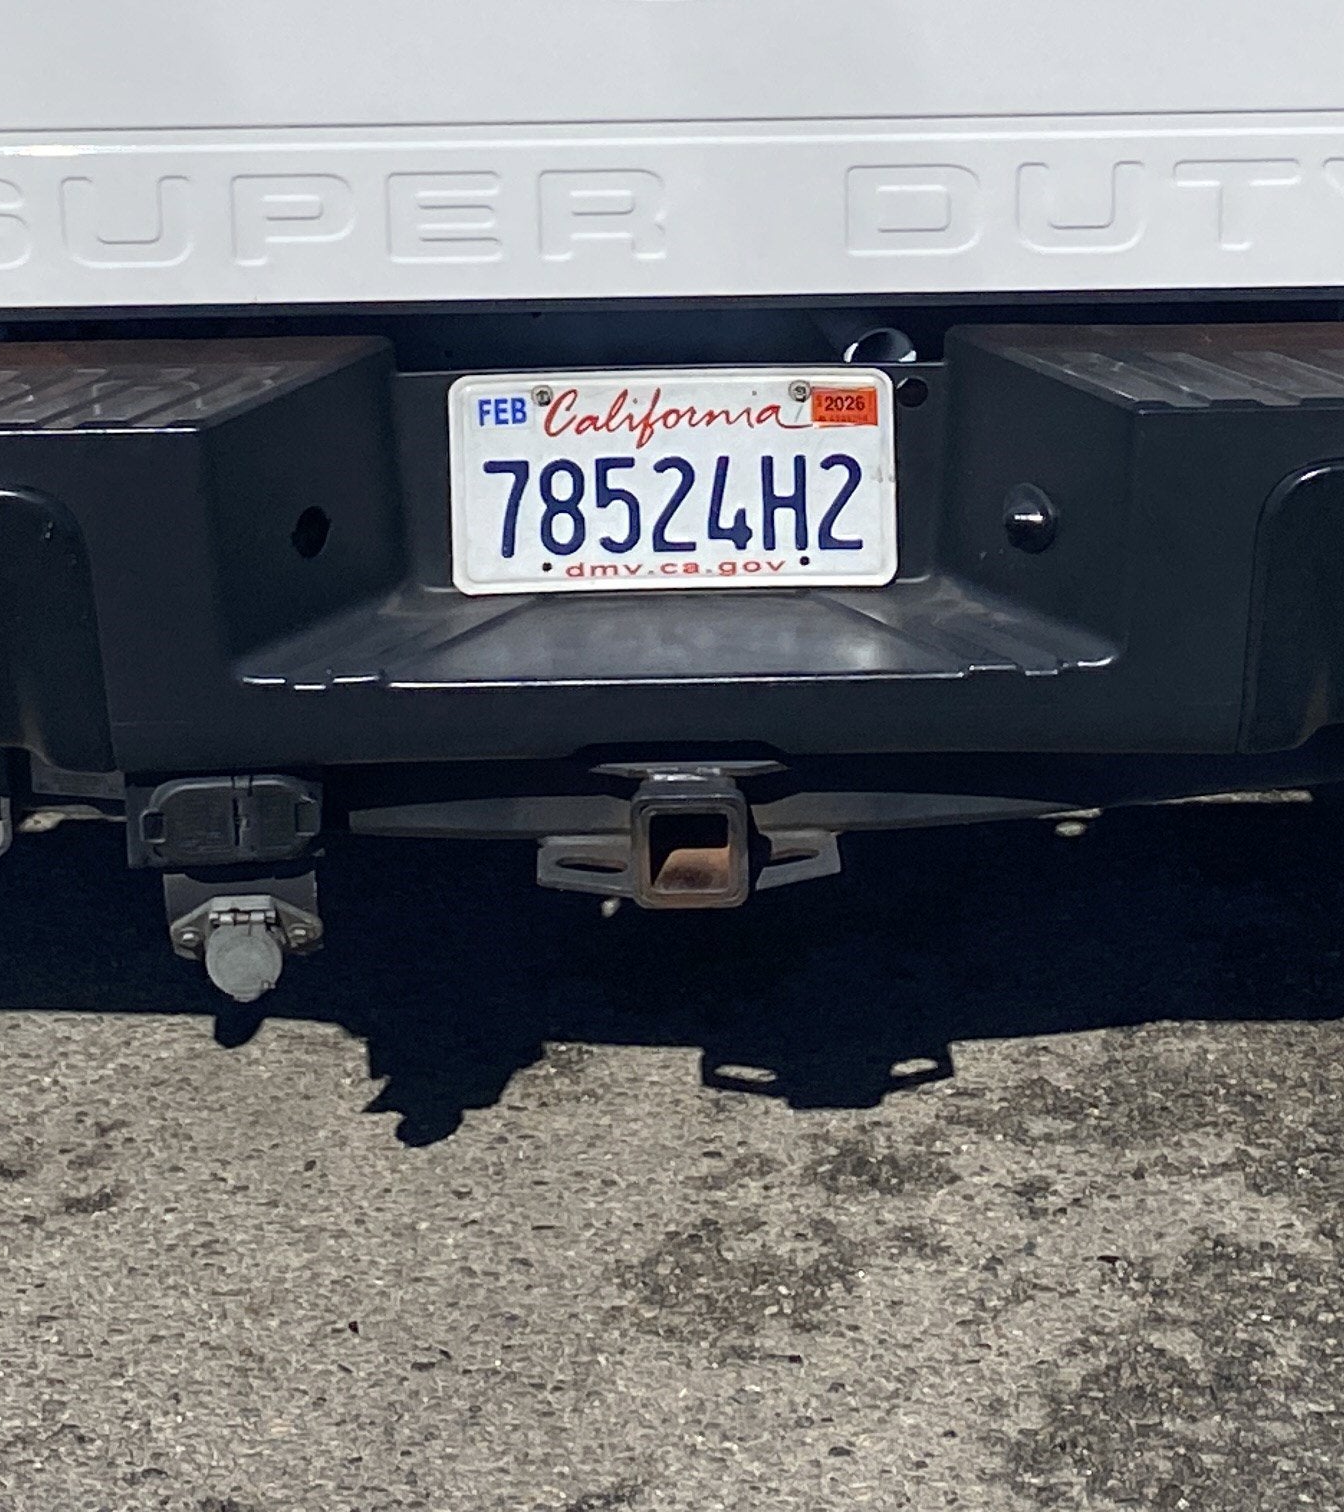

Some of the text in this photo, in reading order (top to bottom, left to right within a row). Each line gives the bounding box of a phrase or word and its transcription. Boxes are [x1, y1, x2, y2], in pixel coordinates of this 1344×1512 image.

[478, 386, 866, 449] FEB California 2026
[483, 453, 864, 559] 78524H2
[565, 555, 787, 579] dmv.ca.gov
